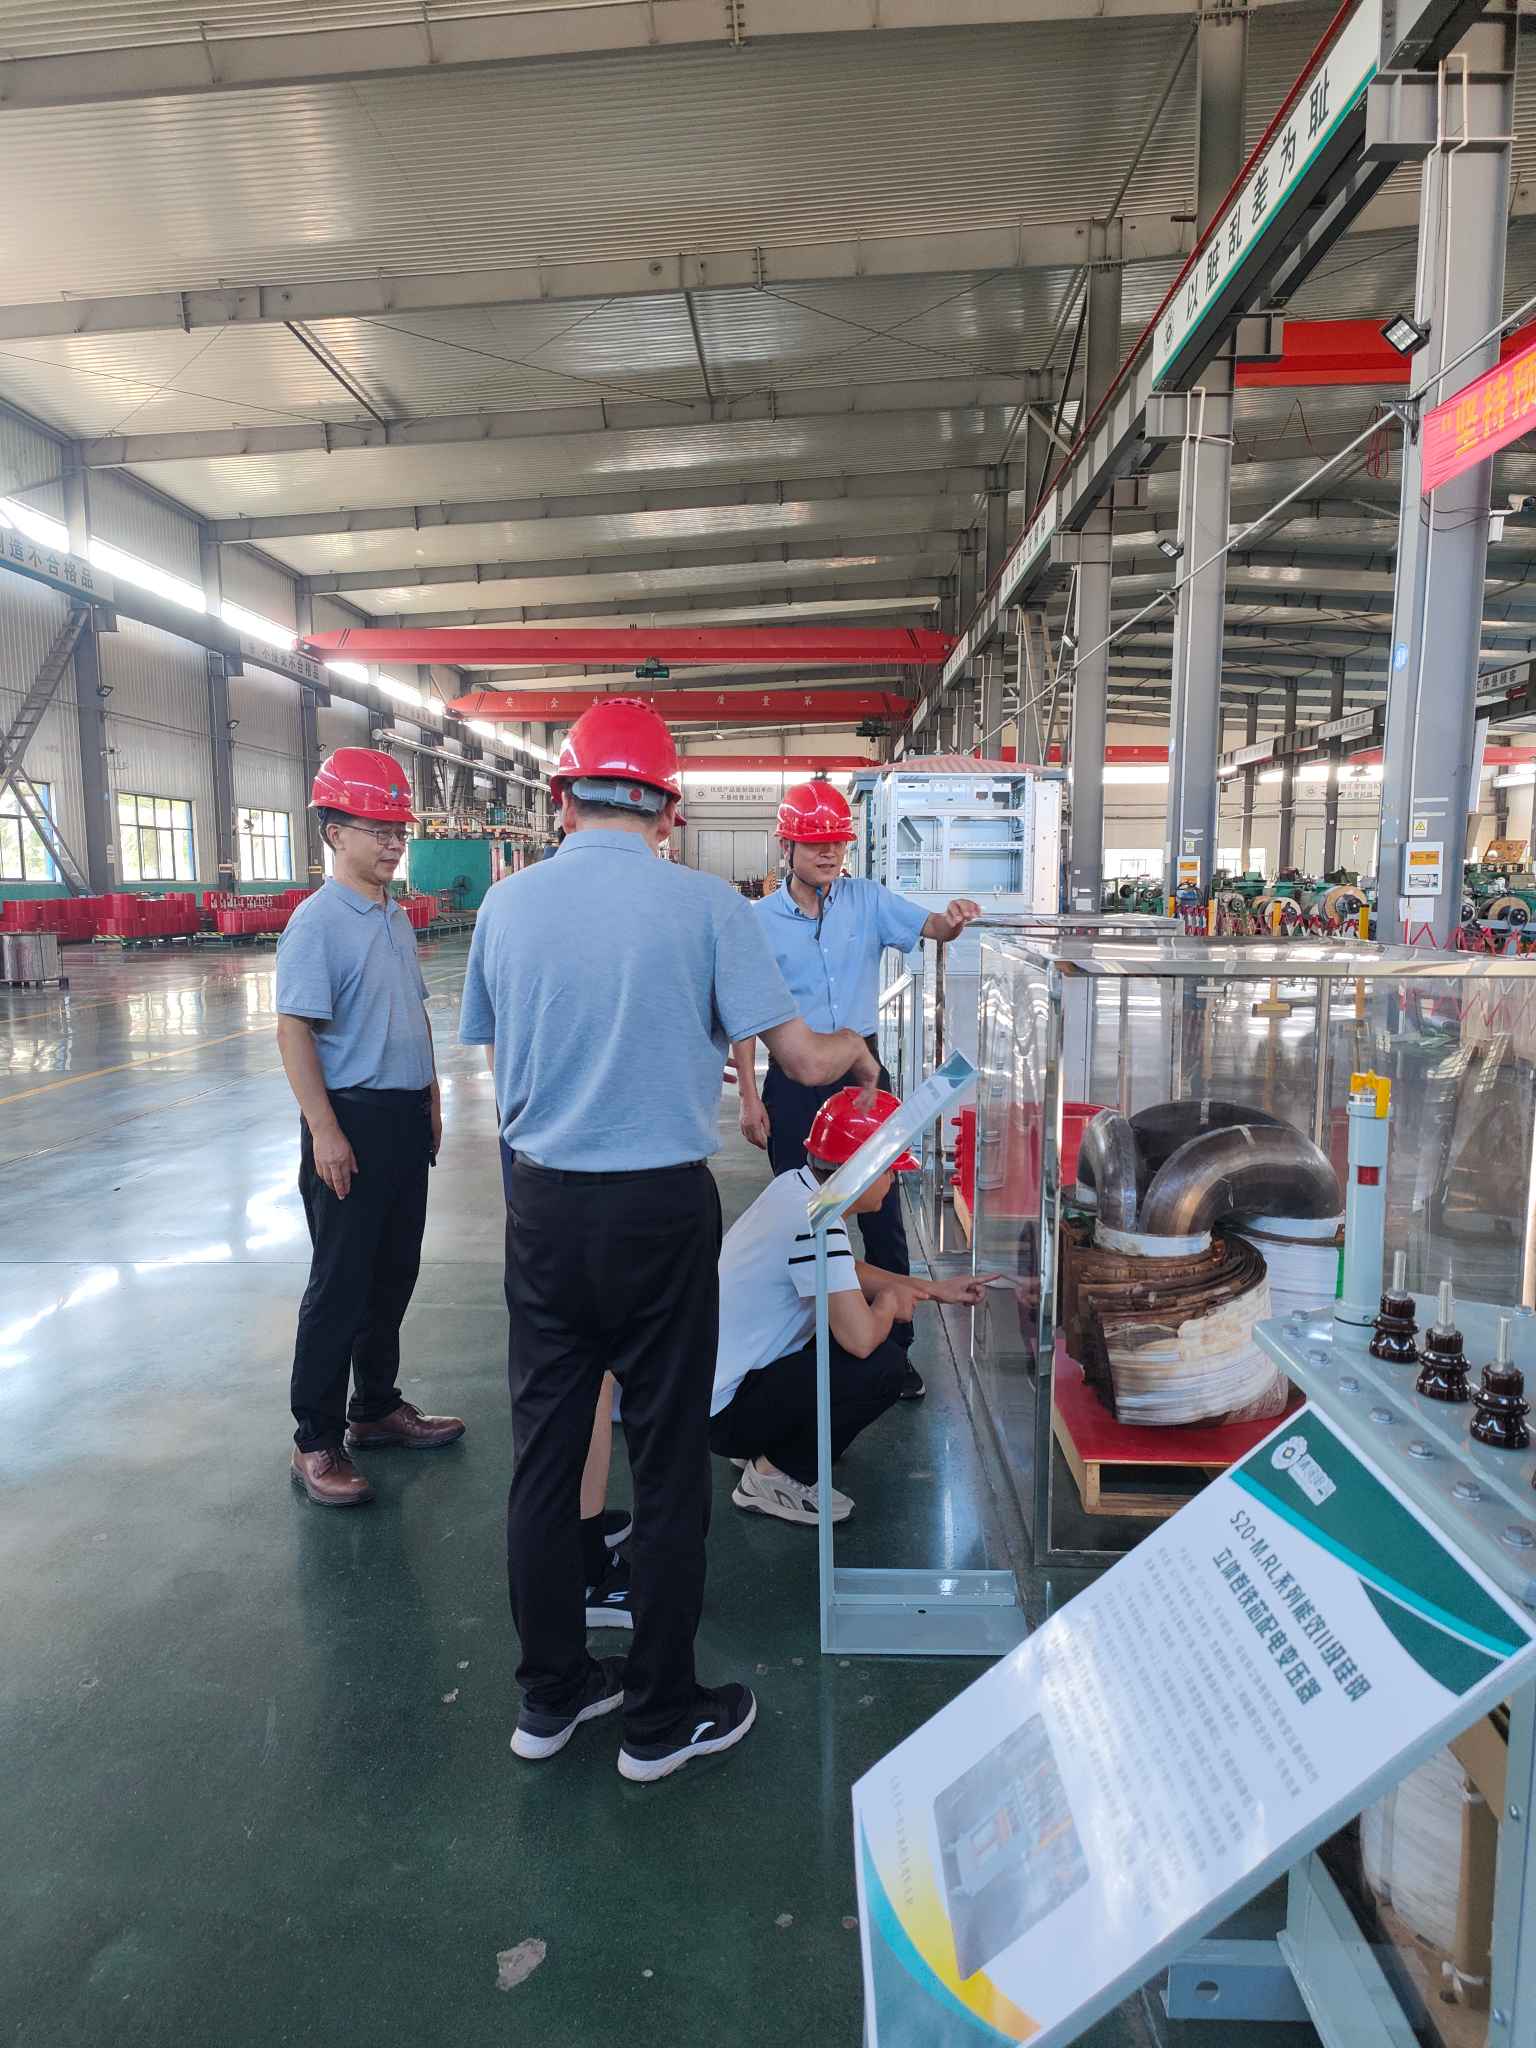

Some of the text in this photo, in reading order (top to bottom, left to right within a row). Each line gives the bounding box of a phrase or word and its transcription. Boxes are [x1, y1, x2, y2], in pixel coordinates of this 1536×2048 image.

[1186, 68, 1330, 320] 以脏乱差为耻
